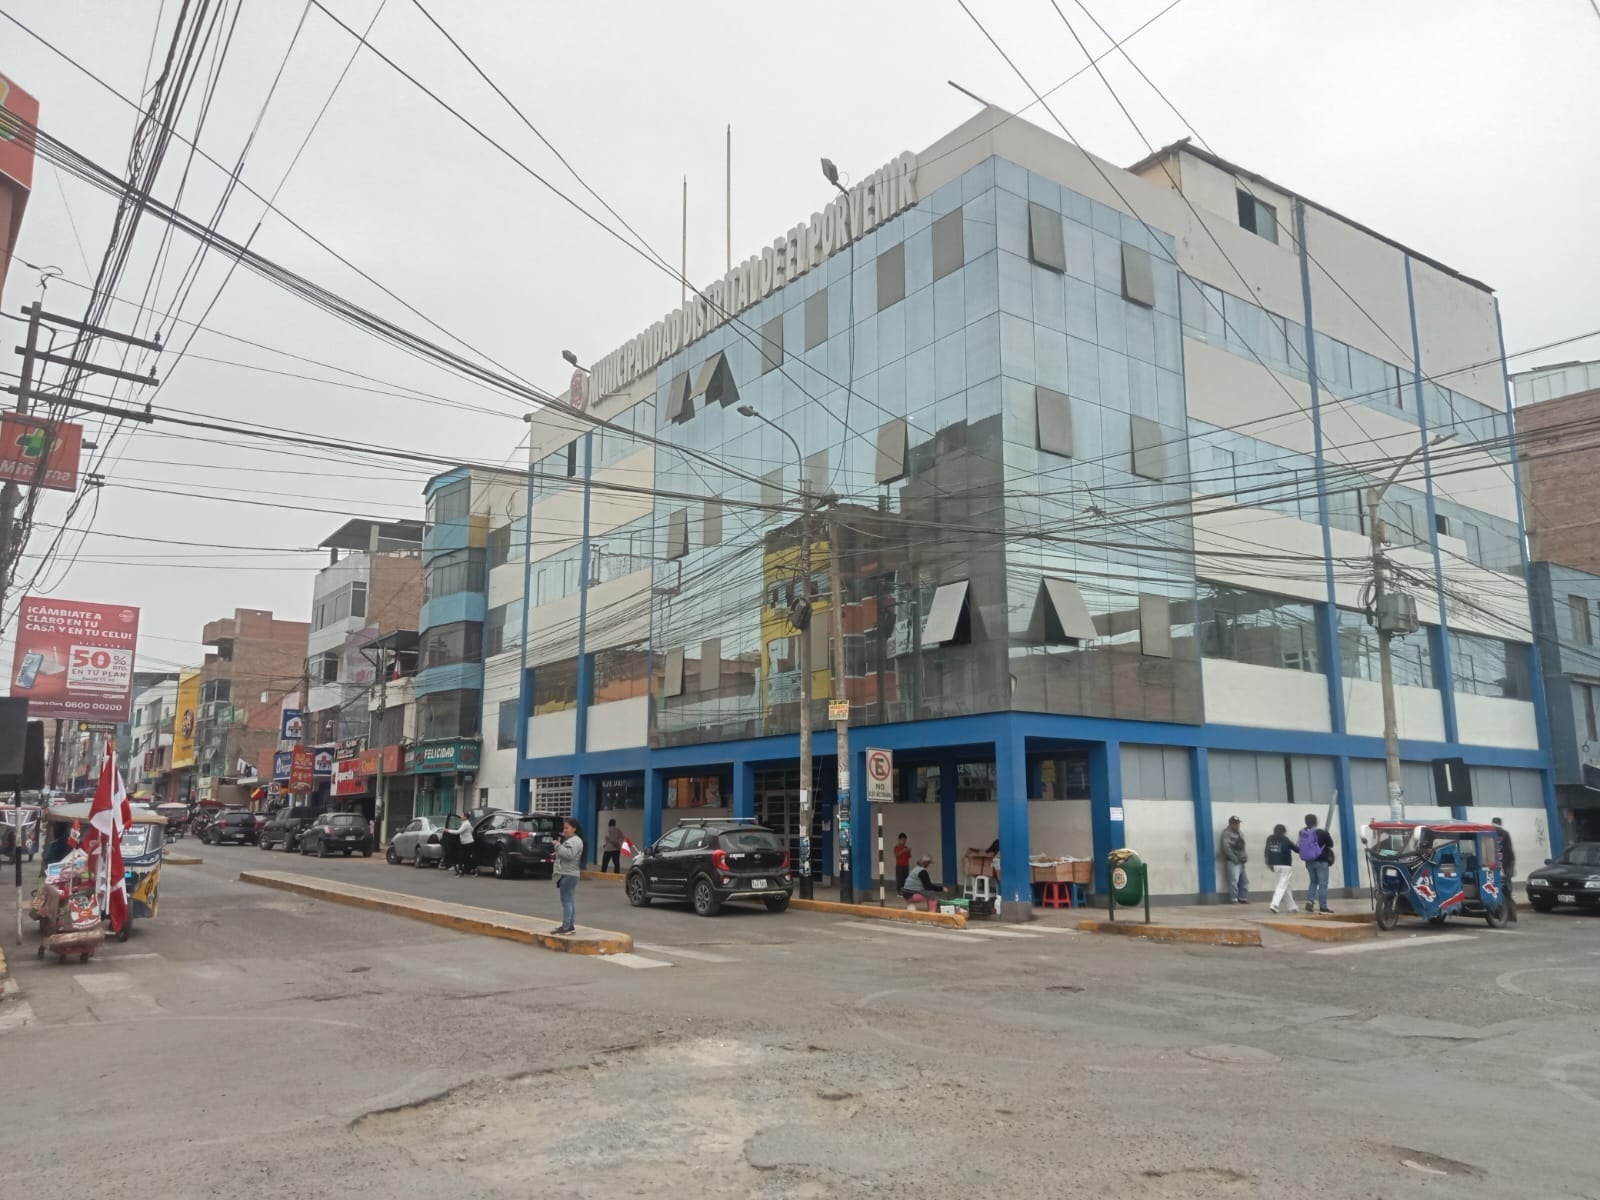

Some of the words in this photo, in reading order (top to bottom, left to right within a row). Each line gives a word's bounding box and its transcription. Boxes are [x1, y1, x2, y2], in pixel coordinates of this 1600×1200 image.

[588, 308, 682, 405] MUNICIPALIDAD
[682, 254, 761, 346] DISTRITAL
[761, 236, 786, 297] DE
[786, 222, 810, 282] EL
[809, 150, 919, 267] PORVENIR
[0, 460, 71, 480] Mifma
[26, 614, 65, 625] CLARO
[67, 618, 82, 627] EN
[84, 620, 99, 628] TU
[25, 623, 56, 633] CASA
[68, 628, 83, 636] EN
[85, 629, 100, 637] TU
[101, 630, 132, 640] CELU!
[73, 649, 111, 669] 50
[71, 668, 84, 676] EN
[87, 669, 99, 677] TU
[102, 670, 127, 678] PLAN
[65, 701, 90, 709] 0800
[92, 703, 122, 711] 00200
[423, 746, 455, 760] FELICIDAD
